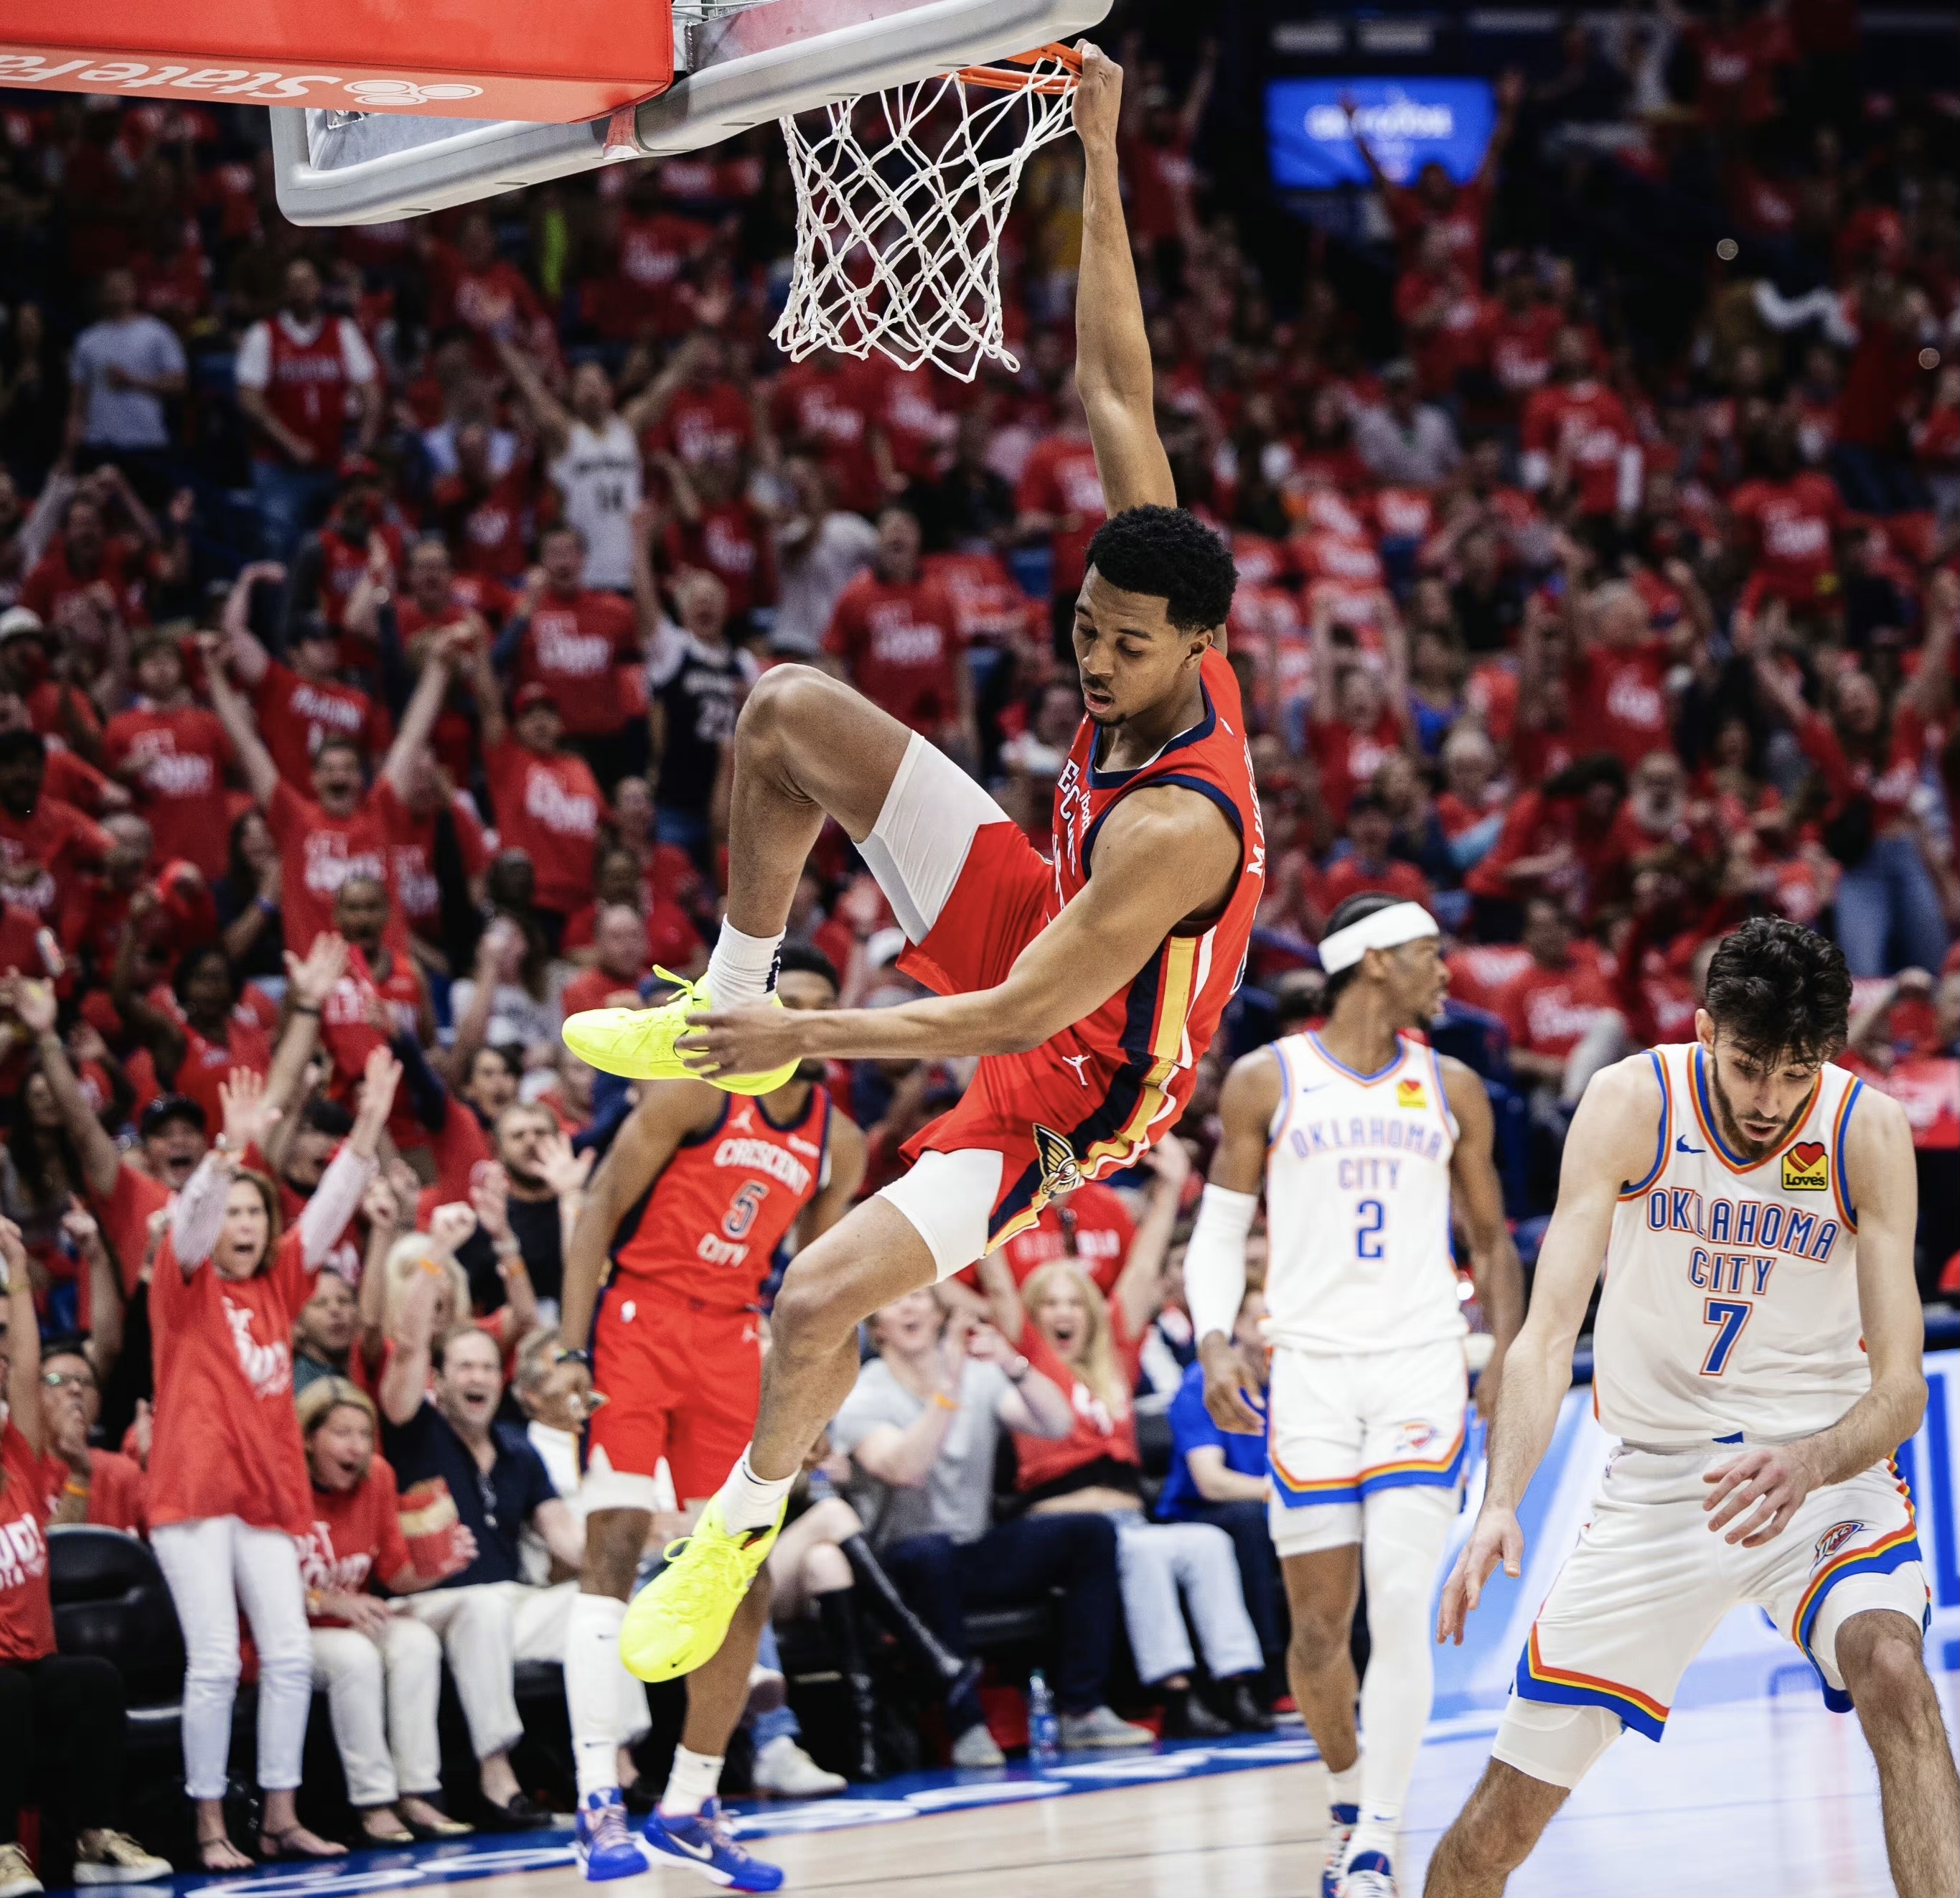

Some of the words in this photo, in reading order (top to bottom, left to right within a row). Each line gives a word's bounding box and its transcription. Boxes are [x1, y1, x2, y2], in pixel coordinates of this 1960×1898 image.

[713, 1137, 812, 1197] CRESCENT
[1290, 1117, 1442, 1160] OKLAHOMA
[1338, 1158, 1400, 1189] CITY
[721, 1179, 769, 1240] 5
[1356, 1197, 1387, 1261] 2
[1647, 1186, 1840, 1263] OKLAHOMA
[696, 1232, 749, 1268] CITY
[1688, 1246, 1777, 1295] CITY
[1699, 1297, 1753, 1375] 7
